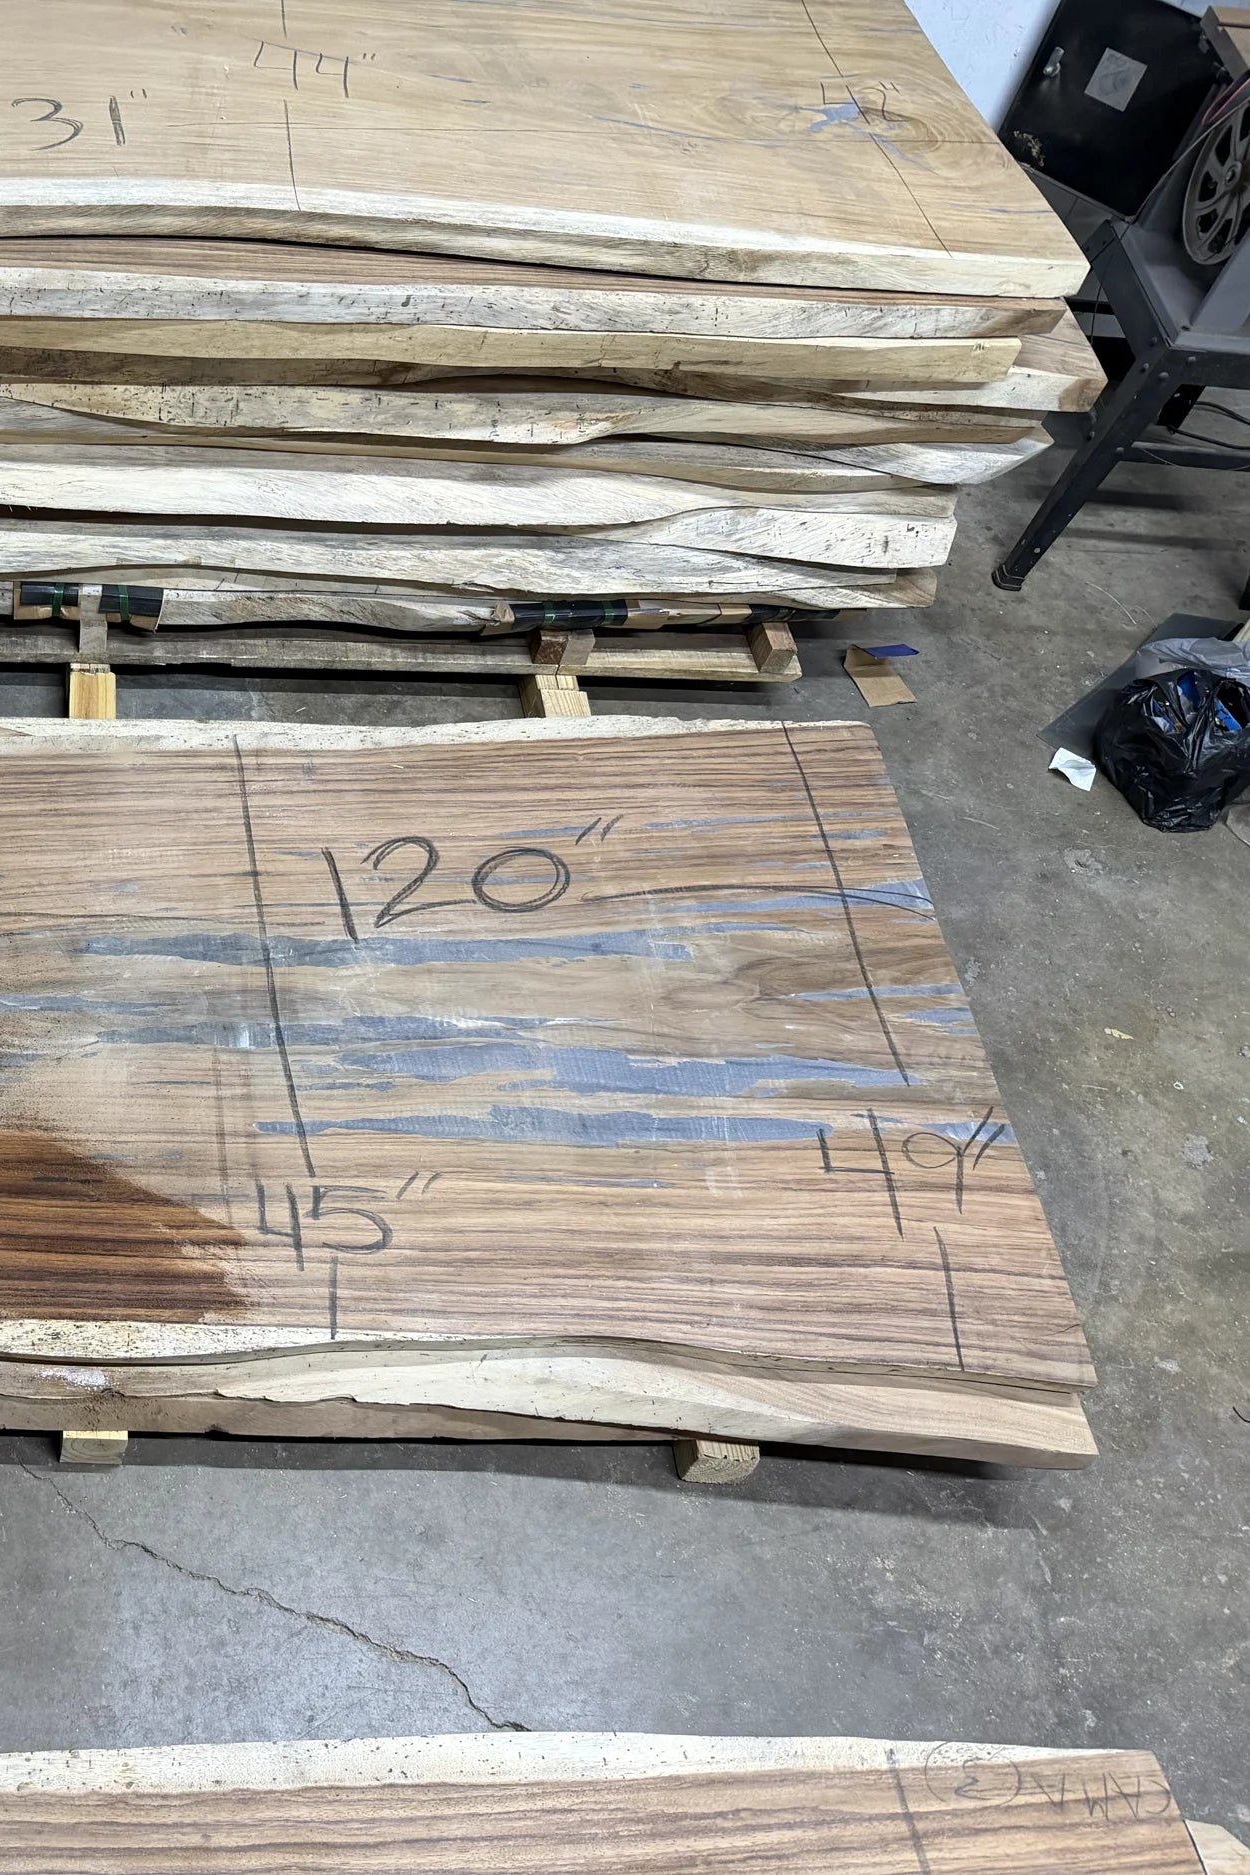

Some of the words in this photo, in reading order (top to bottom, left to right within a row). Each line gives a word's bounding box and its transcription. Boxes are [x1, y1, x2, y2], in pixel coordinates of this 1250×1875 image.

[252, 41, 377, 99] 44"
[320, 813, 625, 944] 120"
[254, 1169, 443, 1272] 45"
[1029, 1771, 1172, 1822] CAMA
